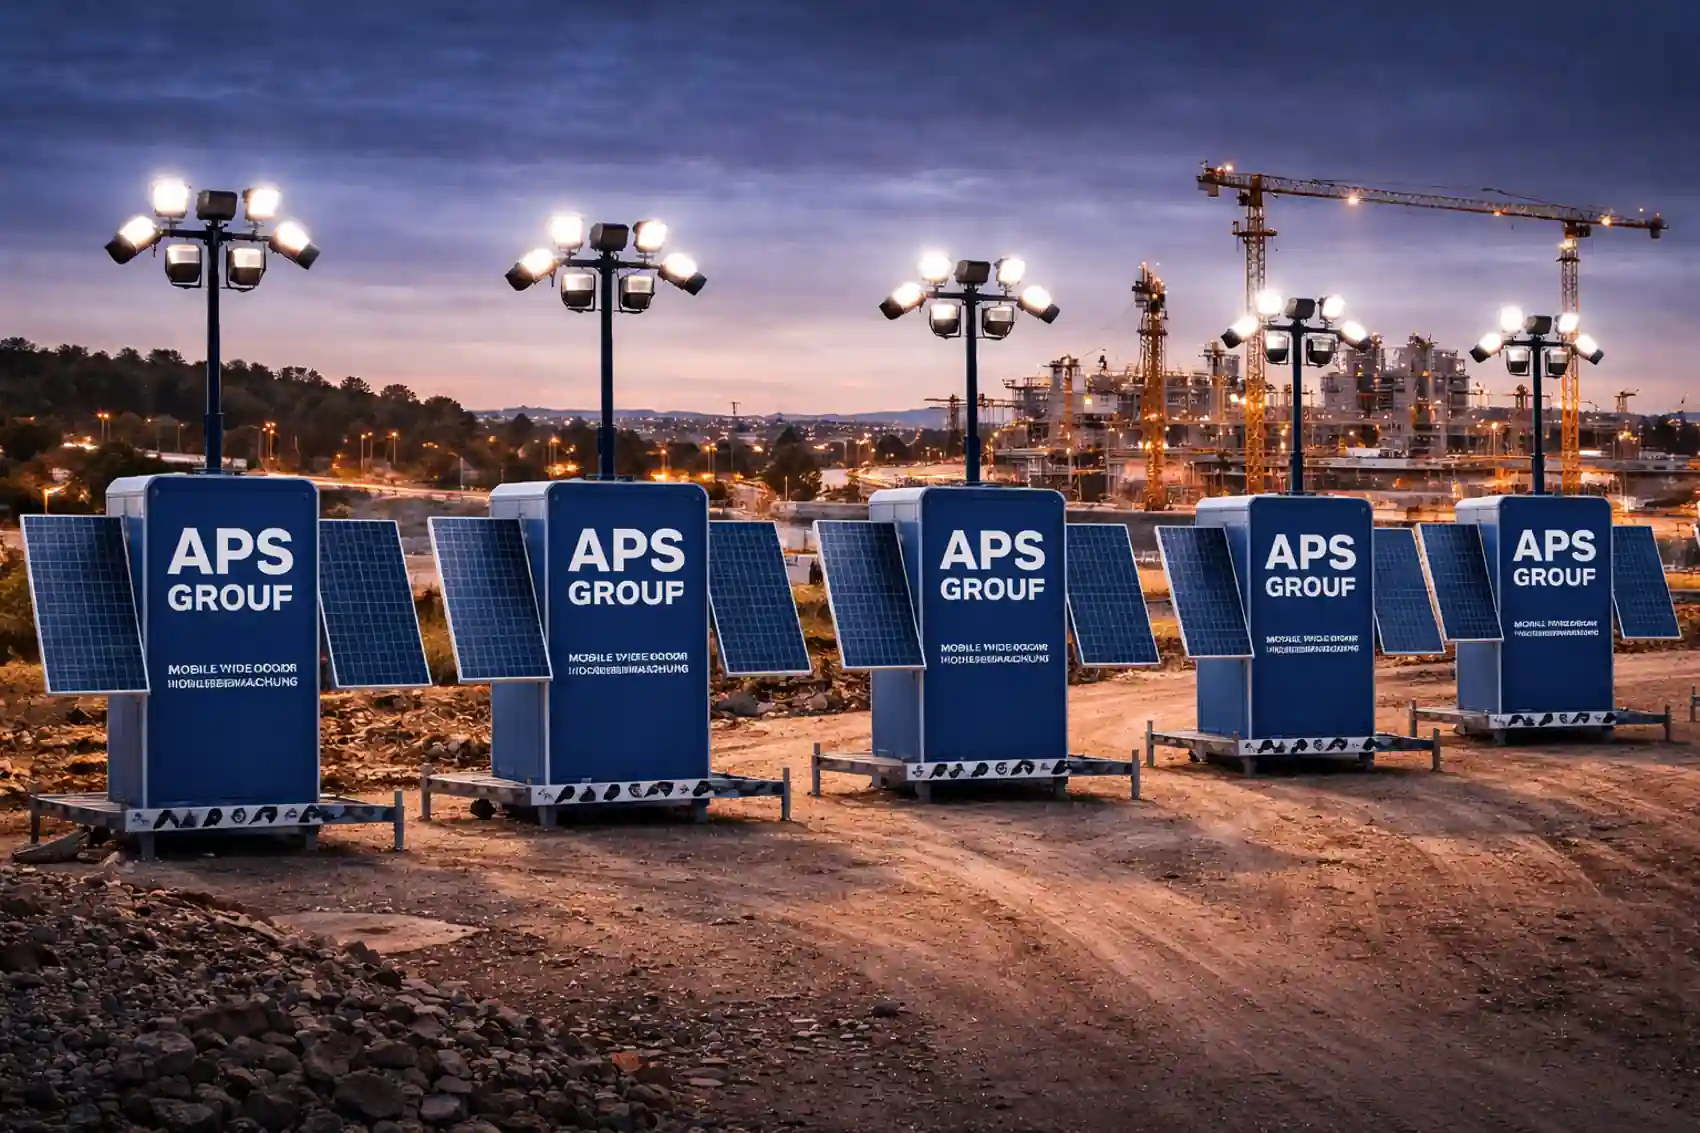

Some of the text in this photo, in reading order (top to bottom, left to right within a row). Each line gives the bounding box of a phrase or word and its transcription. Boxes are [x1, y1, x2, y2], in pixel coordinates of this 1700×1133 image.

[167, 527, 294, 576] APS
[567, 527, 685, 573] APS
[939, 529, 1046, 571] APS
[1264, 533, 1357, 571] APS
[1512, 529, 1597, 562] APS
[167, 664, 218, 675] MOBILE
[219, 663, 253, 674] WIDE
